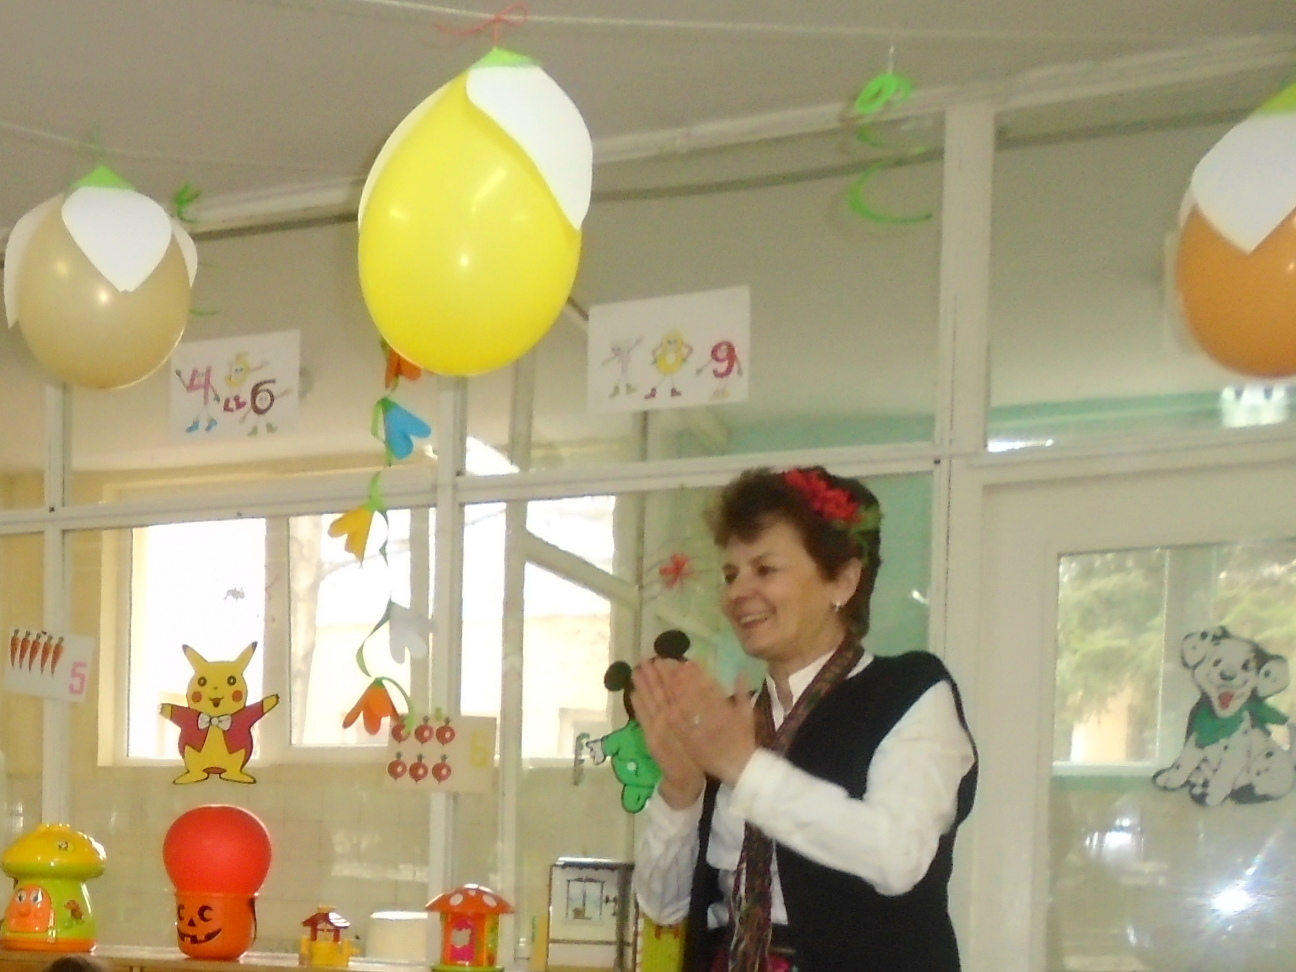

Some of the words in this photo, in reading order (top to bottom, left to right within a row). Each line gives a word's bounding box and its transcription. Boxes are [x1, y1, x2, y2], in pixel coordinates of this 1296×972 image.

[711, 340, 735, 378] 9
[186, 364, 212, 405] 4
[250, 379, 276, 415] 6
[68, 660, 88, 695] 5
